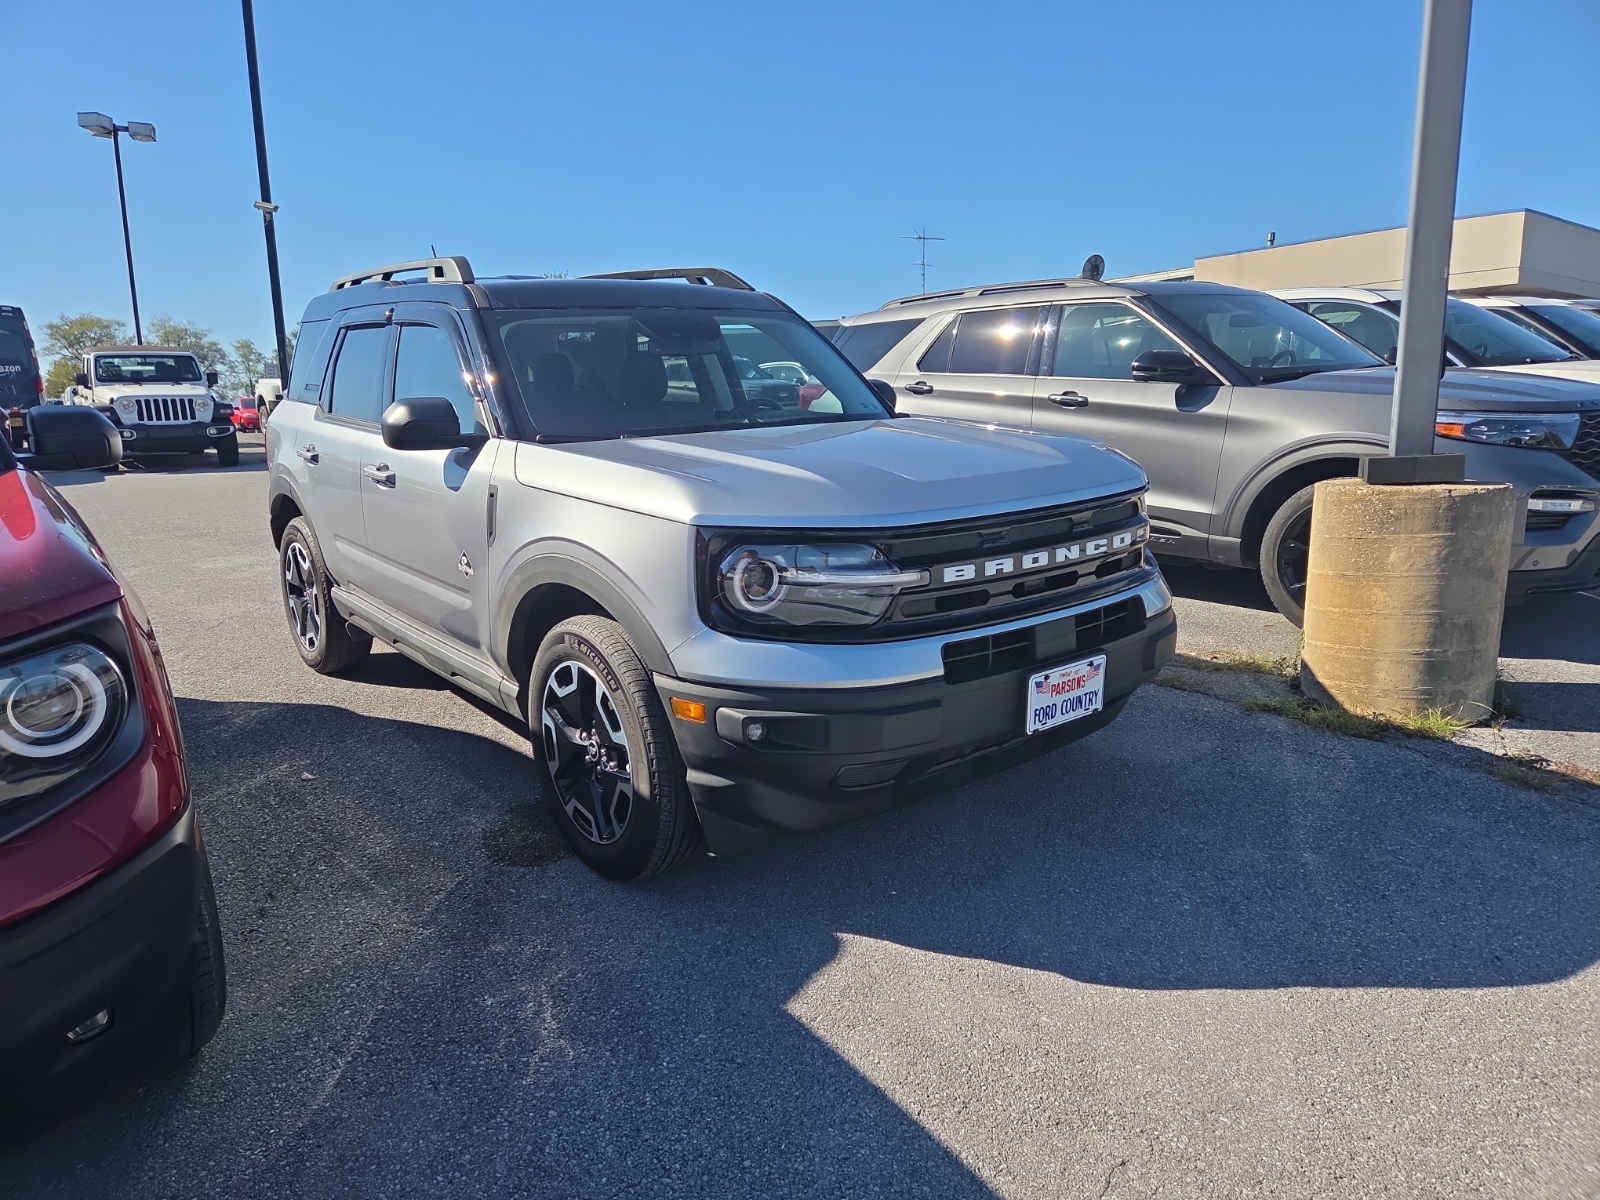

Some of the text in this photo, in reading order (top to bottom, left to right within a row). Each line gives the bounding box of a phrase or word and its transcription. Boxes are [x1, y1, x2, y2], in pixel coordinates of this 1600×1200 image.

[943, 532, 1132, 583] BRONCO
[579, 643, 618, 691] MICHELIN
[1050, 674, 1087, 698] PARSONS
[619, 698, 637, 738] PRIMACY
[1033, 688, 1100, 726] FORD COUNTRY
